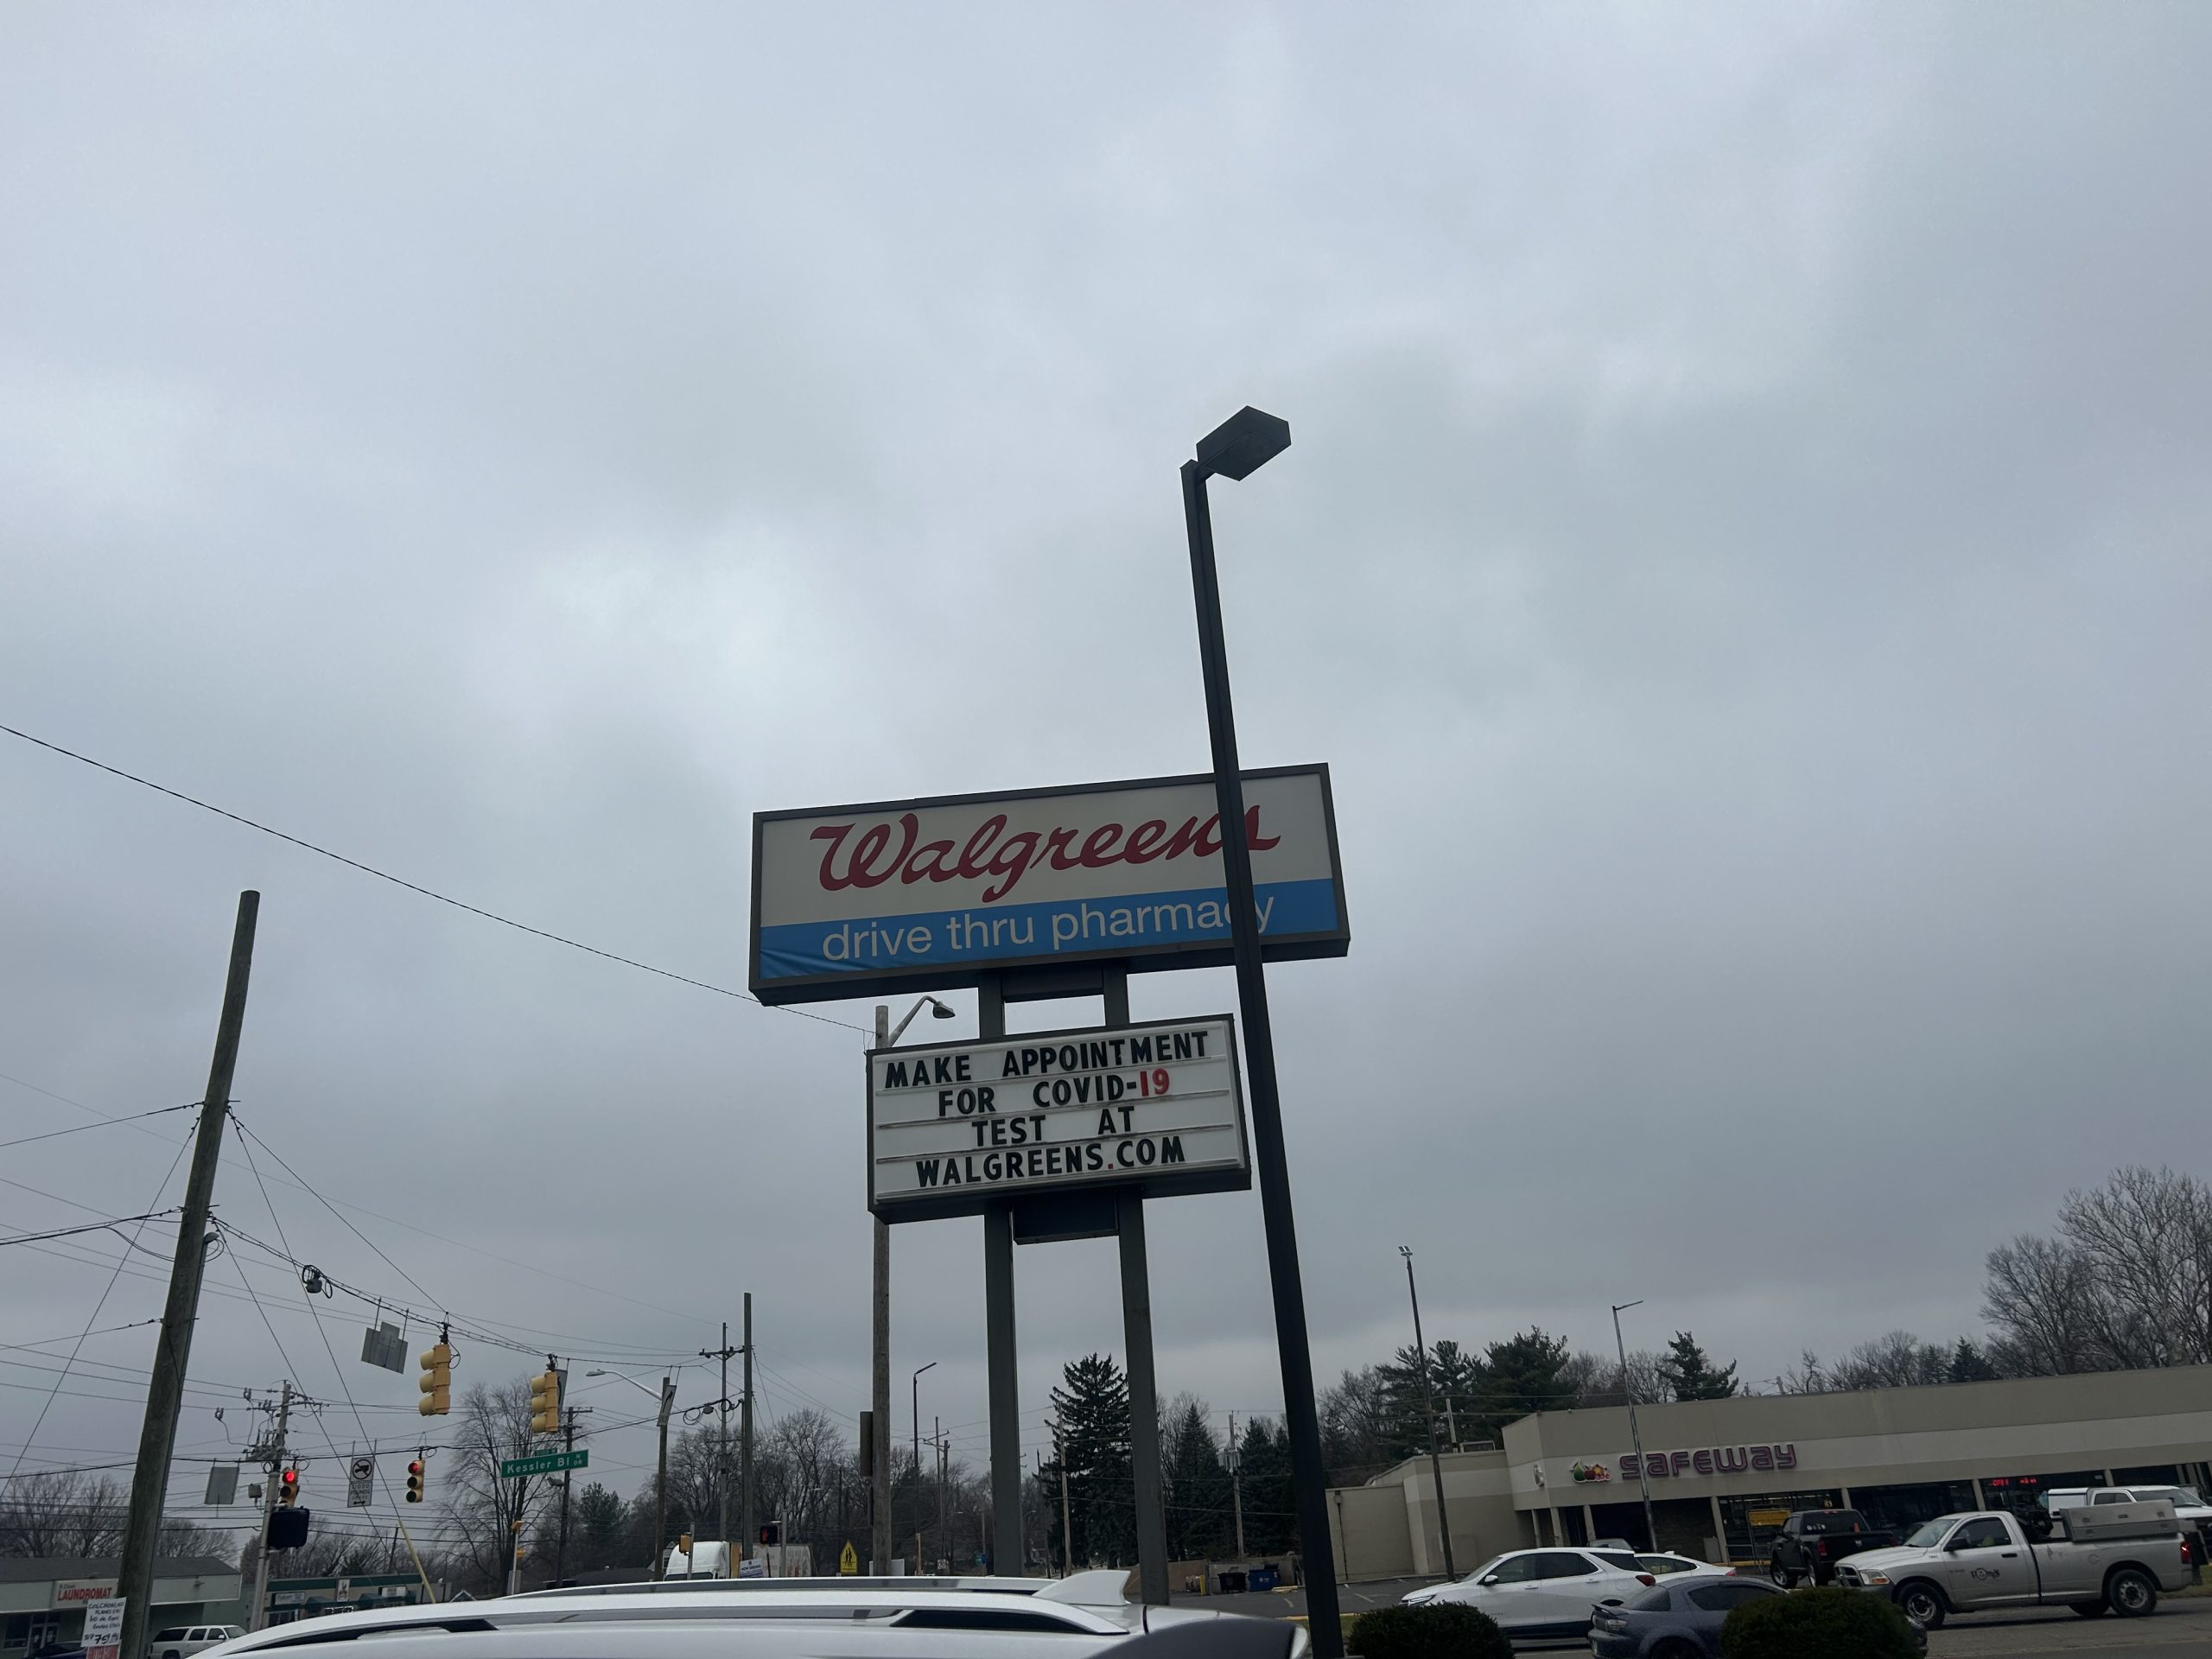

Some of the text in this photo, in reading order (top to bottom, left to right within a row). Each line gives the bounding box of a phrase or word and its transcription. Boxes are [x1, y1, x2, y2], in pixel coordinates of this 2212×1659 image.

[810, 804, 1281, 903] Walgreens
[822, 895, 1274, 962] drive thru pharmay
[884, 1031, 1209, 1089] MAKE APPOINTMENT
[938, 1068, 1171, 1116] FOR COVID-19
[972, 1105, 1135, 1147] TEST AT
[916, 1135, 1185, 1188] WALGREENS.COM
[507, 1457, 569, 1474] Kessler Bl
[57, 1587, 112, 1601] LAUNDROMAT
